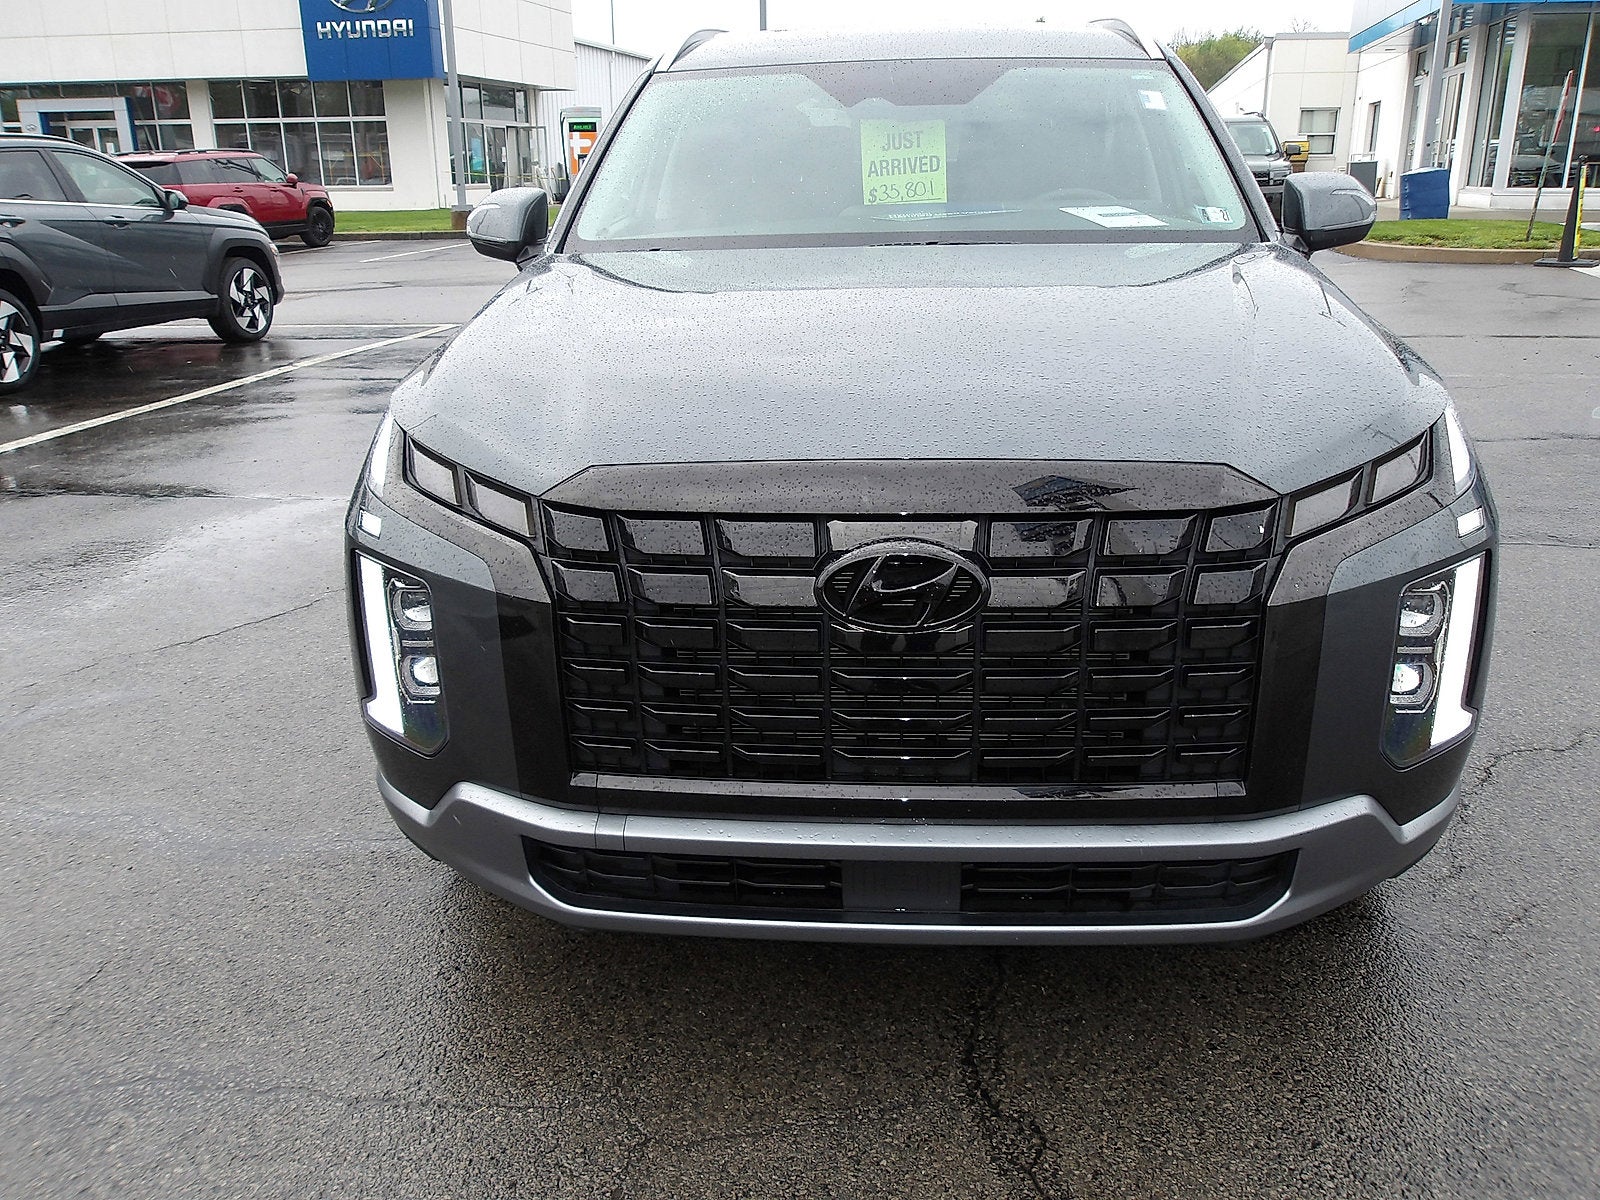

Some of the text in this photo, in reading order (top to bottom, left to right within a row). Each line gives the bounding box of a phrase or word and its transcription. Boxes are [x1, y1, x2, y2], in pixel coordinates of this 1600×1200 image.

[316, 19, 414, 39] HYUNDAI
[882, 130, 923, 151] JUST
[868, 155, 941, 177] ARRIVED
[868, 180, 934, 203] $35,801
